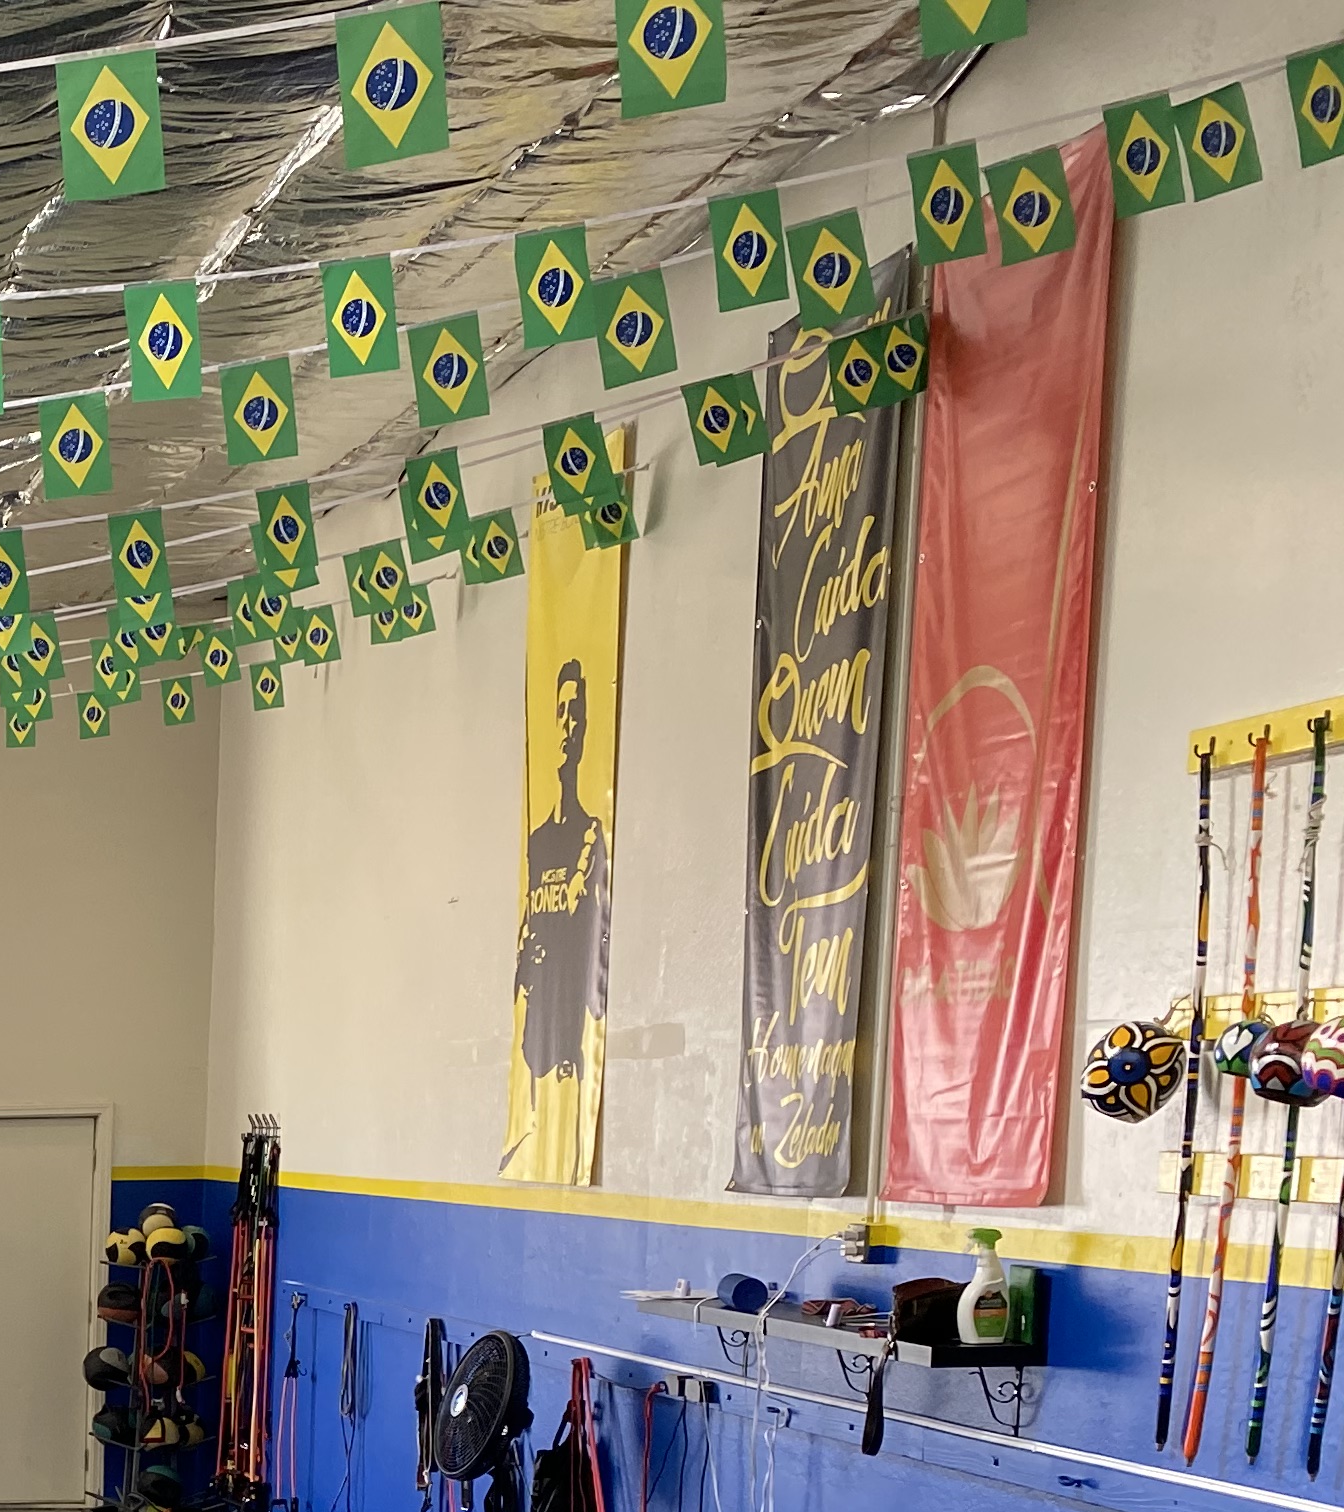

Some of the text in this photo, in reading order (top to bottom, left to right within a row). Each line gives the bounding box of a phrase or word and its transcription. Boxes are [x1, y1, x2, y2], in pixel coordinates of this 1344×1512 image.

[794, 515, 889, 663] Cuida
[751, 648, 871, 776] Quem
[759, 761, 861, 907] Cuida
[779, 861, 868, 1026] Tem
